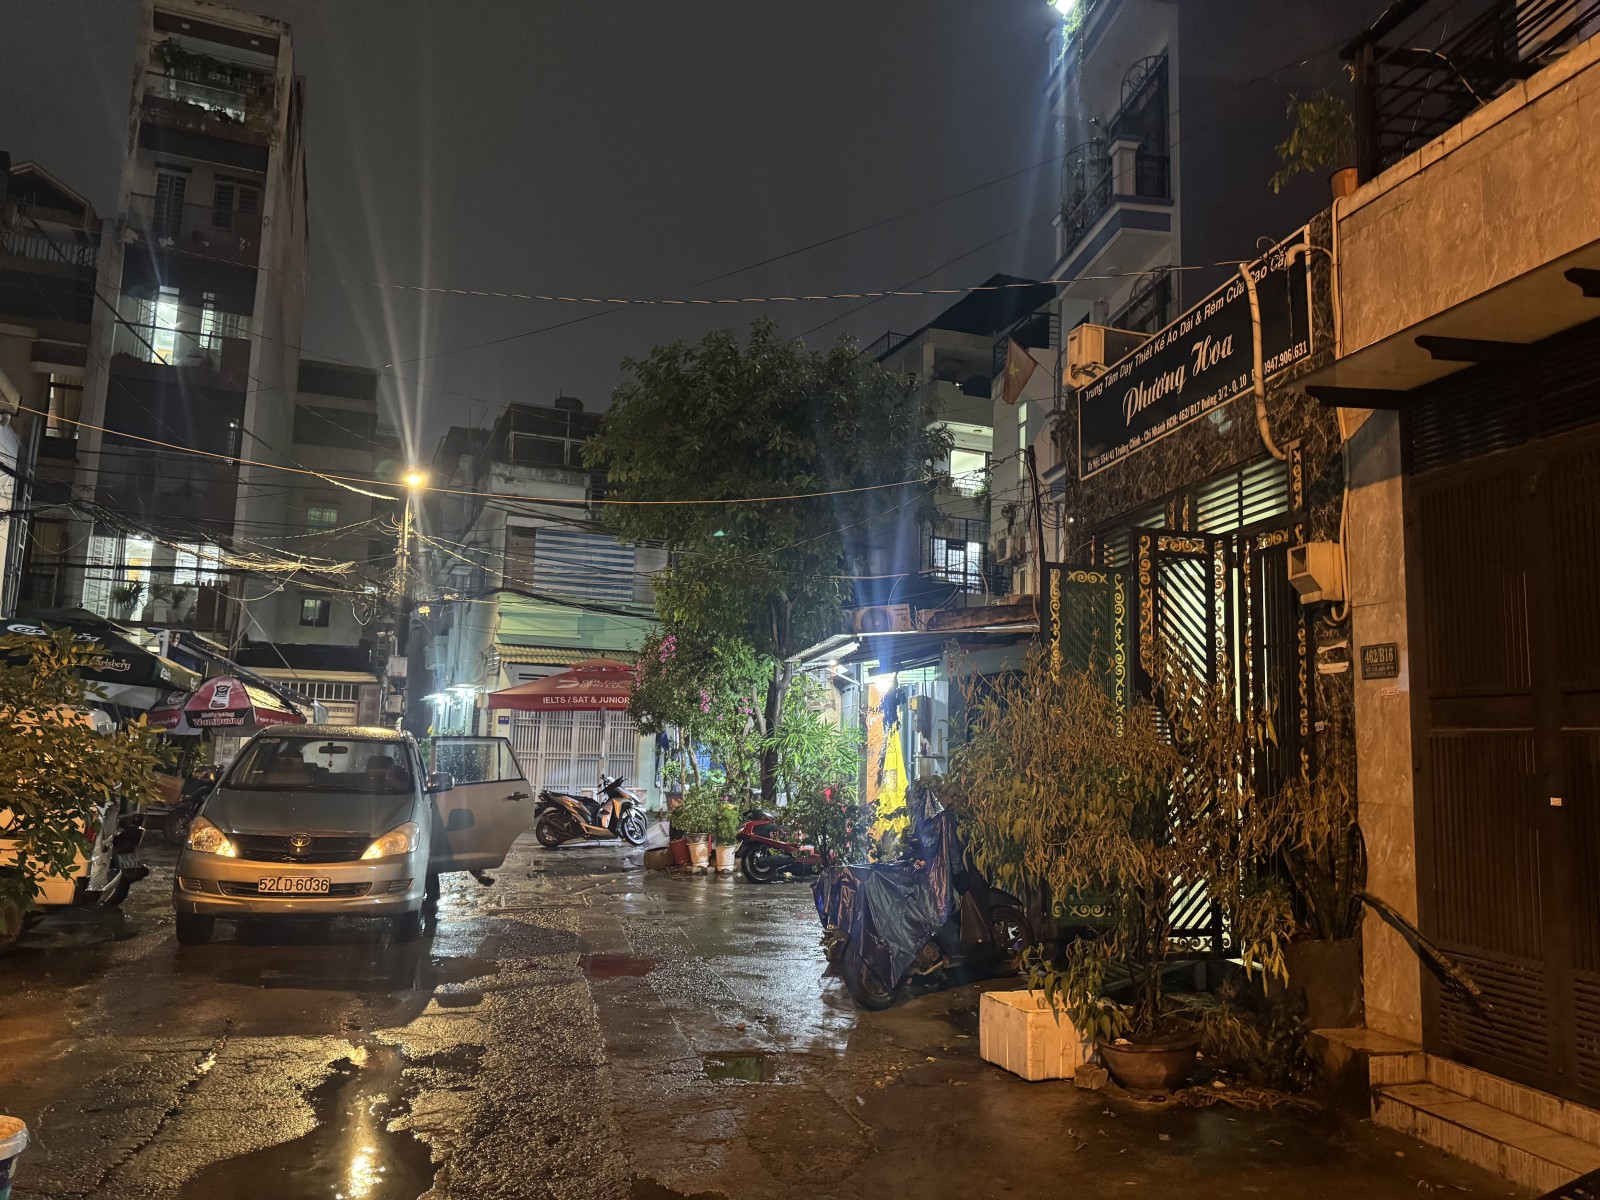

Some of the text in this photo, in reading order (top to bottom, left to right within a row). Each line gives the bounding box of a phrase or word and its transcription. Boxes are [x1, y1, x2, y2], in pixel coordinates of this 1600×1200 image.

[1134, 344, 1153, 367] Thiết
[1154, 334, 1166, 355] Kế
[1166, 327, 1178, 346] Áo
[1179, 315, 1194, 337] Dài
[1195, 310, 1202, 326] &
[1204, 296, 1224, 320] Rèm
[1226, 280, 1245, 303] Cửa
[1122, 333, 1235, 427] Phương Hoa
[1217, 384, 1228, 401] 3/2
[1231, 379, 1239, 394] Q.
[1239, 373, 1247, 389] 10
[1365, 648, 1394, 664] 462/B16
[542, 696, 566, 704] IELTS
[572, 696, 588, 704] SAT
[590, 696, 597, 704] &
[599, 696, 630, 704] JUNIOR
[259, 878, 329, 892] 52LD-6036
